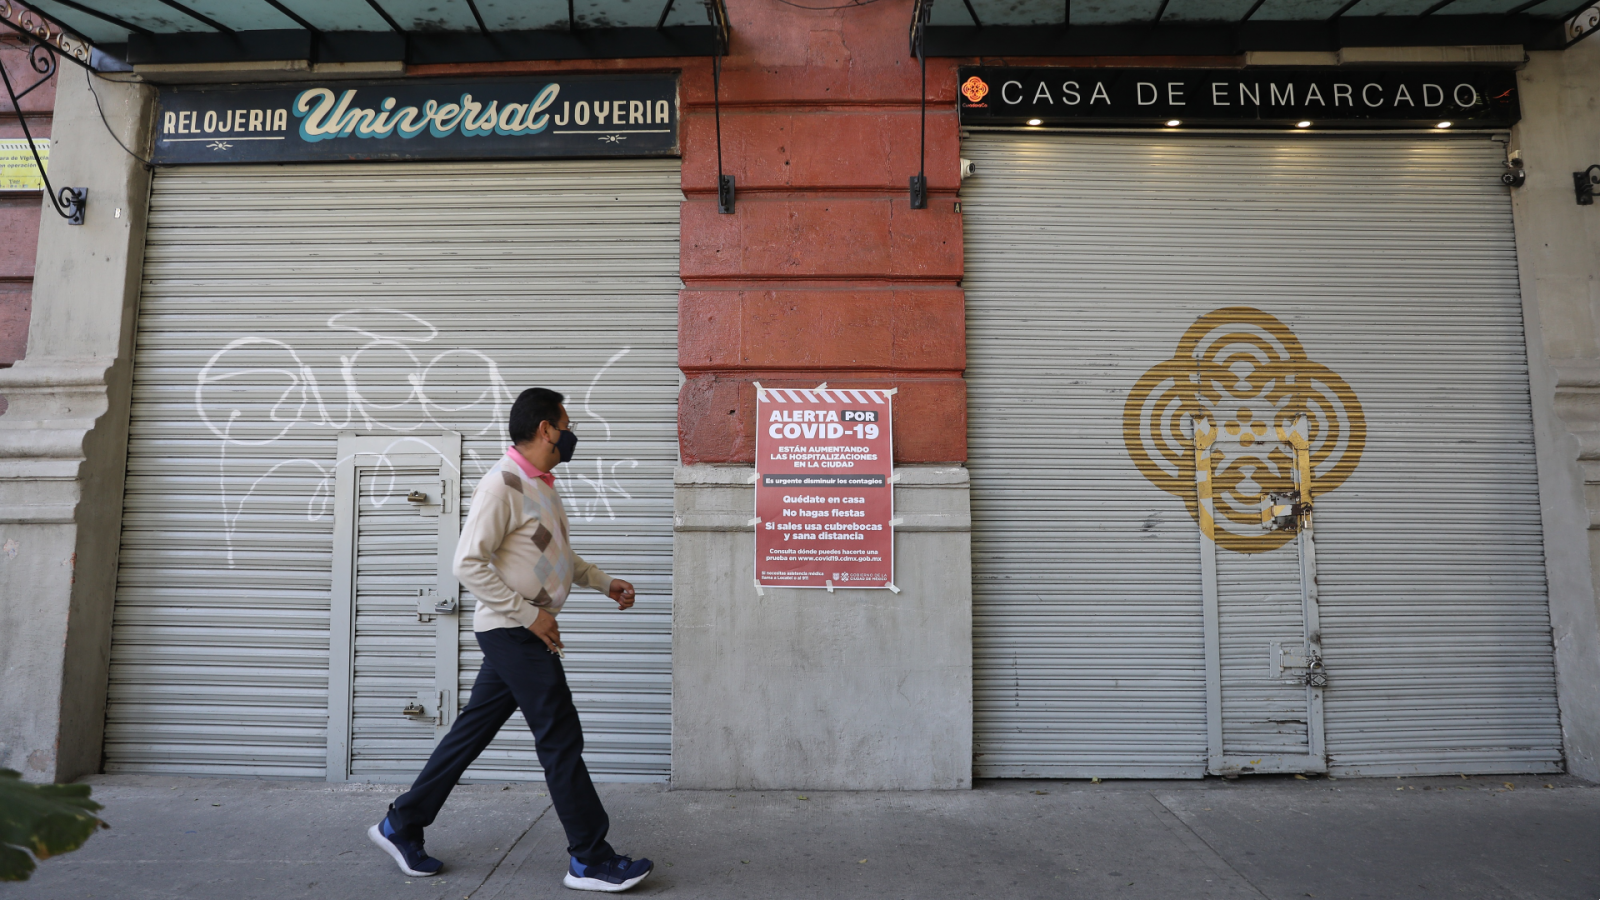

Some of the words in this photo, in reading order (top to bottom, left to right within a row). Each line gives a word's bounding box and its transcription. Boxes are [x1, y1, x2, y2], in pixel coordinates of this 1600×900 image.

[1001, 80, 1112, 106] CASA
[1136, 82, 1187, 106] DE
[1212, 82, 1478, 108] ENMARCADO
[163, 108, 288, 134] RELOJERIA
[292, 83, 561, 143] Universal
[555, 100, 670, 126] JOYERIA
[769, 410, 838, 422] ALERTA
[845, 411, 875, 421] POR
[768, 423, 880, 439] COVID-19
[783, 495, 826, 503] Quédate
[783, 509, 797, 517] No
[799, 509, 829, 518] hagas
[831, 509, 865, 517] fiestas
[765, 522, 775, 530] Si
[777, 522, 802, 530] sales
[824, 522, 883, 530] cubrebocas
[784, 533, 790, 541] y
[818, 532, 864, 540] distancia
